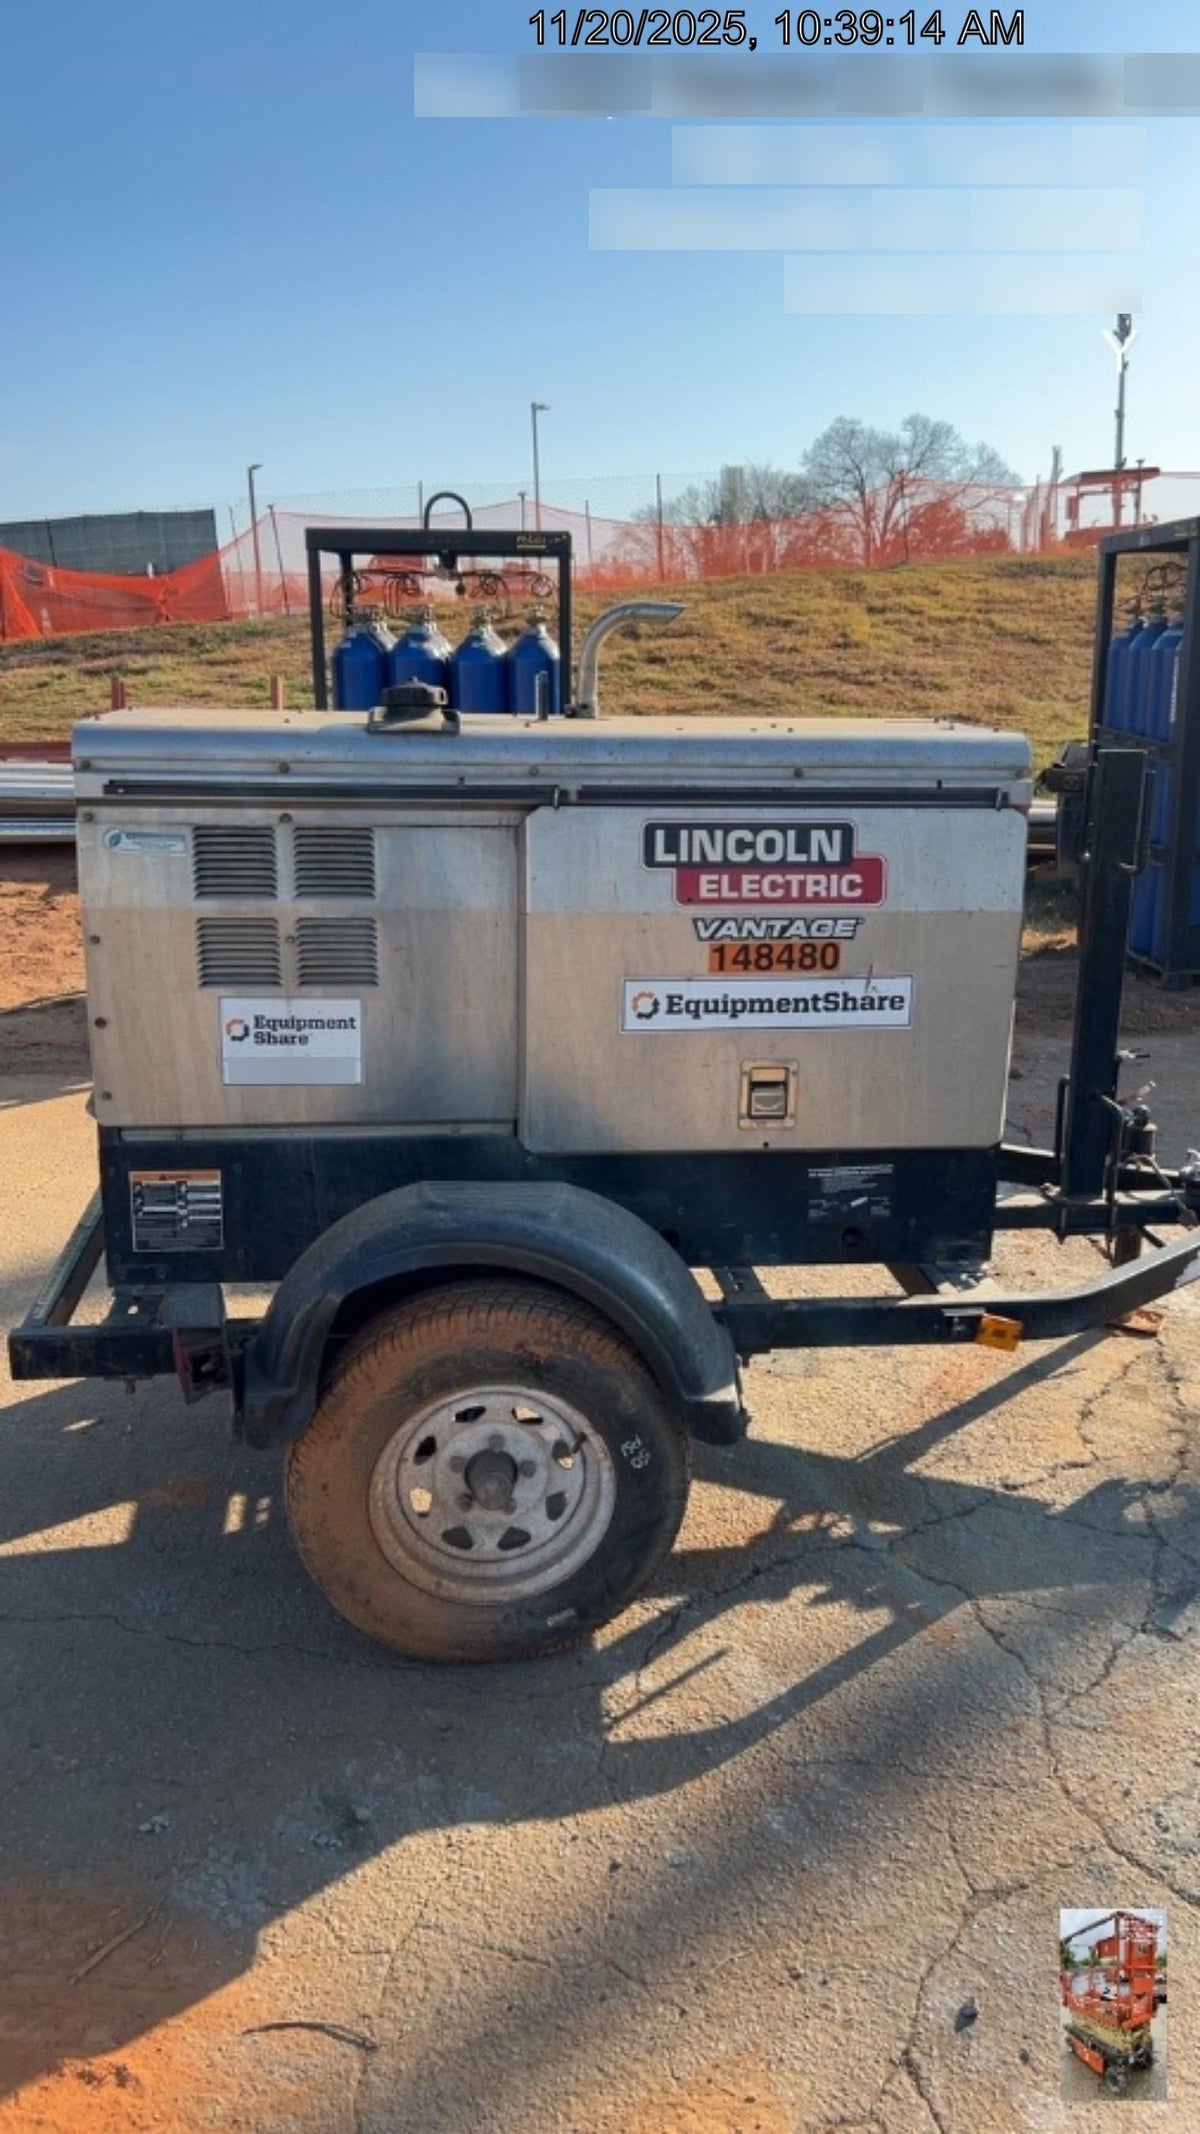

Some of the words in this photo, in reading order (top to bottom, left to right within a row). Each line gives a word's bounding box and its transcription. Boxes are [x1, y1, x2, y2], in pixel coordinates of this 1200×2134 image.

[653, 828, 843, 863] LINCOLN
[699, 873, 864, 900] ELECTRIC
[693, 917, 859, 940] VANTAGE
[712, 943, 841, 972] 148480
[665, 991, 906, 1020] EquipmentShare
[253, 1014, 357, 1032] Equipment
[253, 1031, 310, 1046] Share
